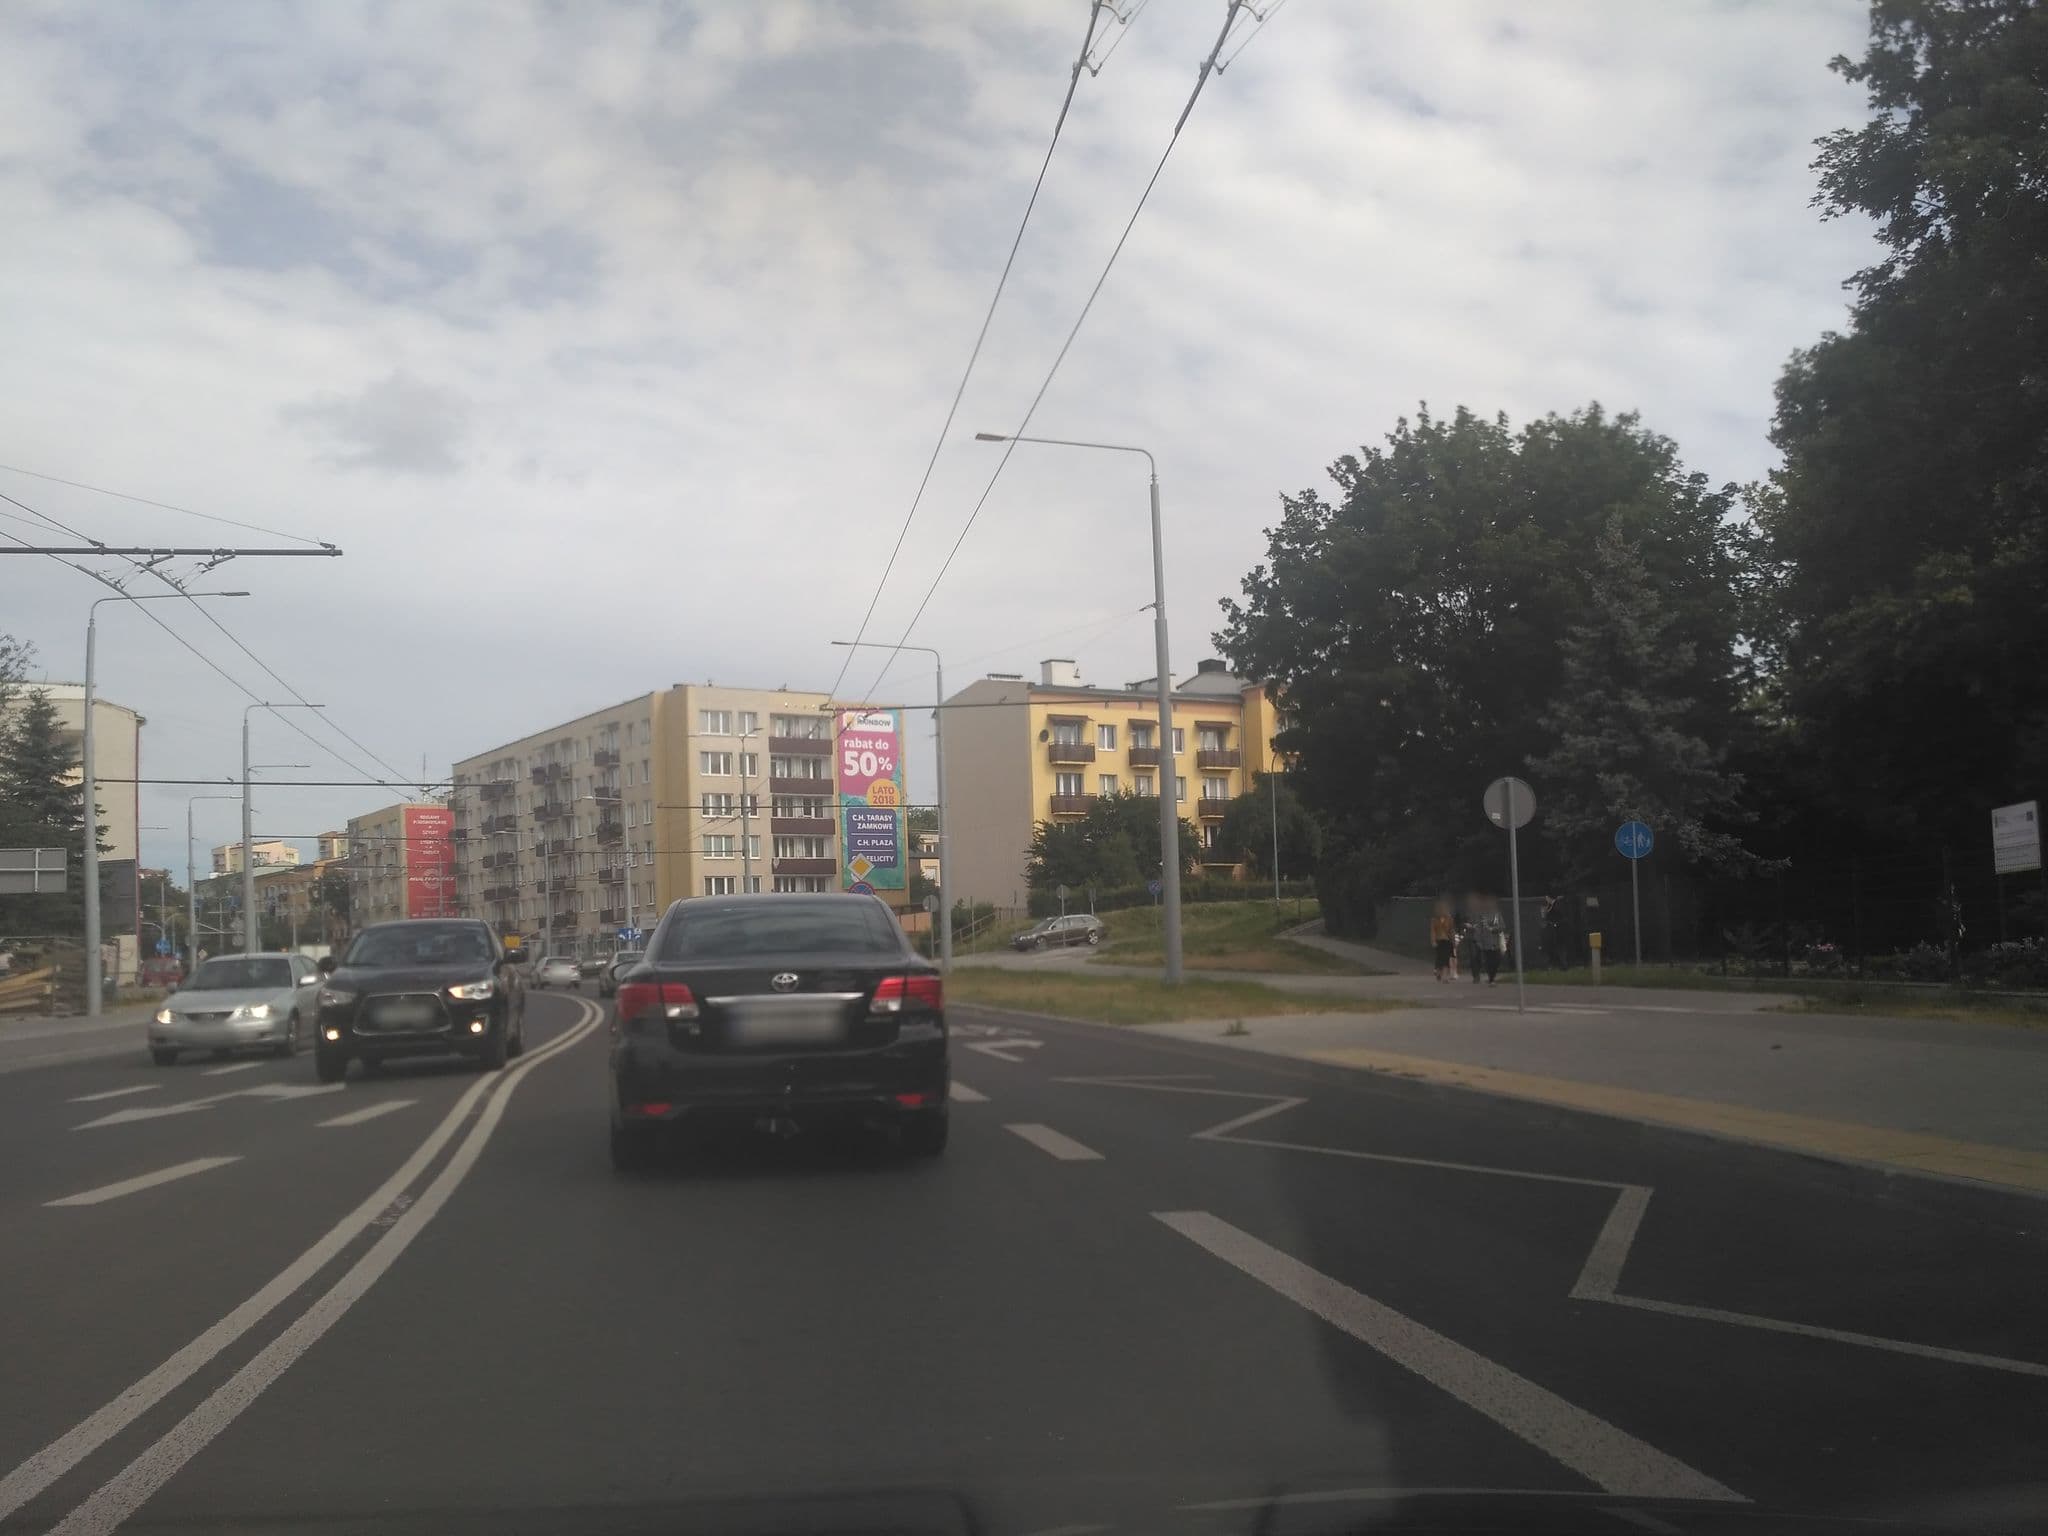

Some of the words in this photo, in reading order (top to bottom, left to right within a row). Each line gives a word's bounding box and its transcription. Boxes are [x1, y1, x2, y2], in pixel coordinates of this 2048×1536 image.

[844, 738, 873, 749] rabat
[875, 738, 889, 750] do
[844, 751, 893, 776] 50%
[872, 786, 895, 795] LATO
[872, 796, 895, 805] 2018
[867, 814, 893, 822] TARASY
